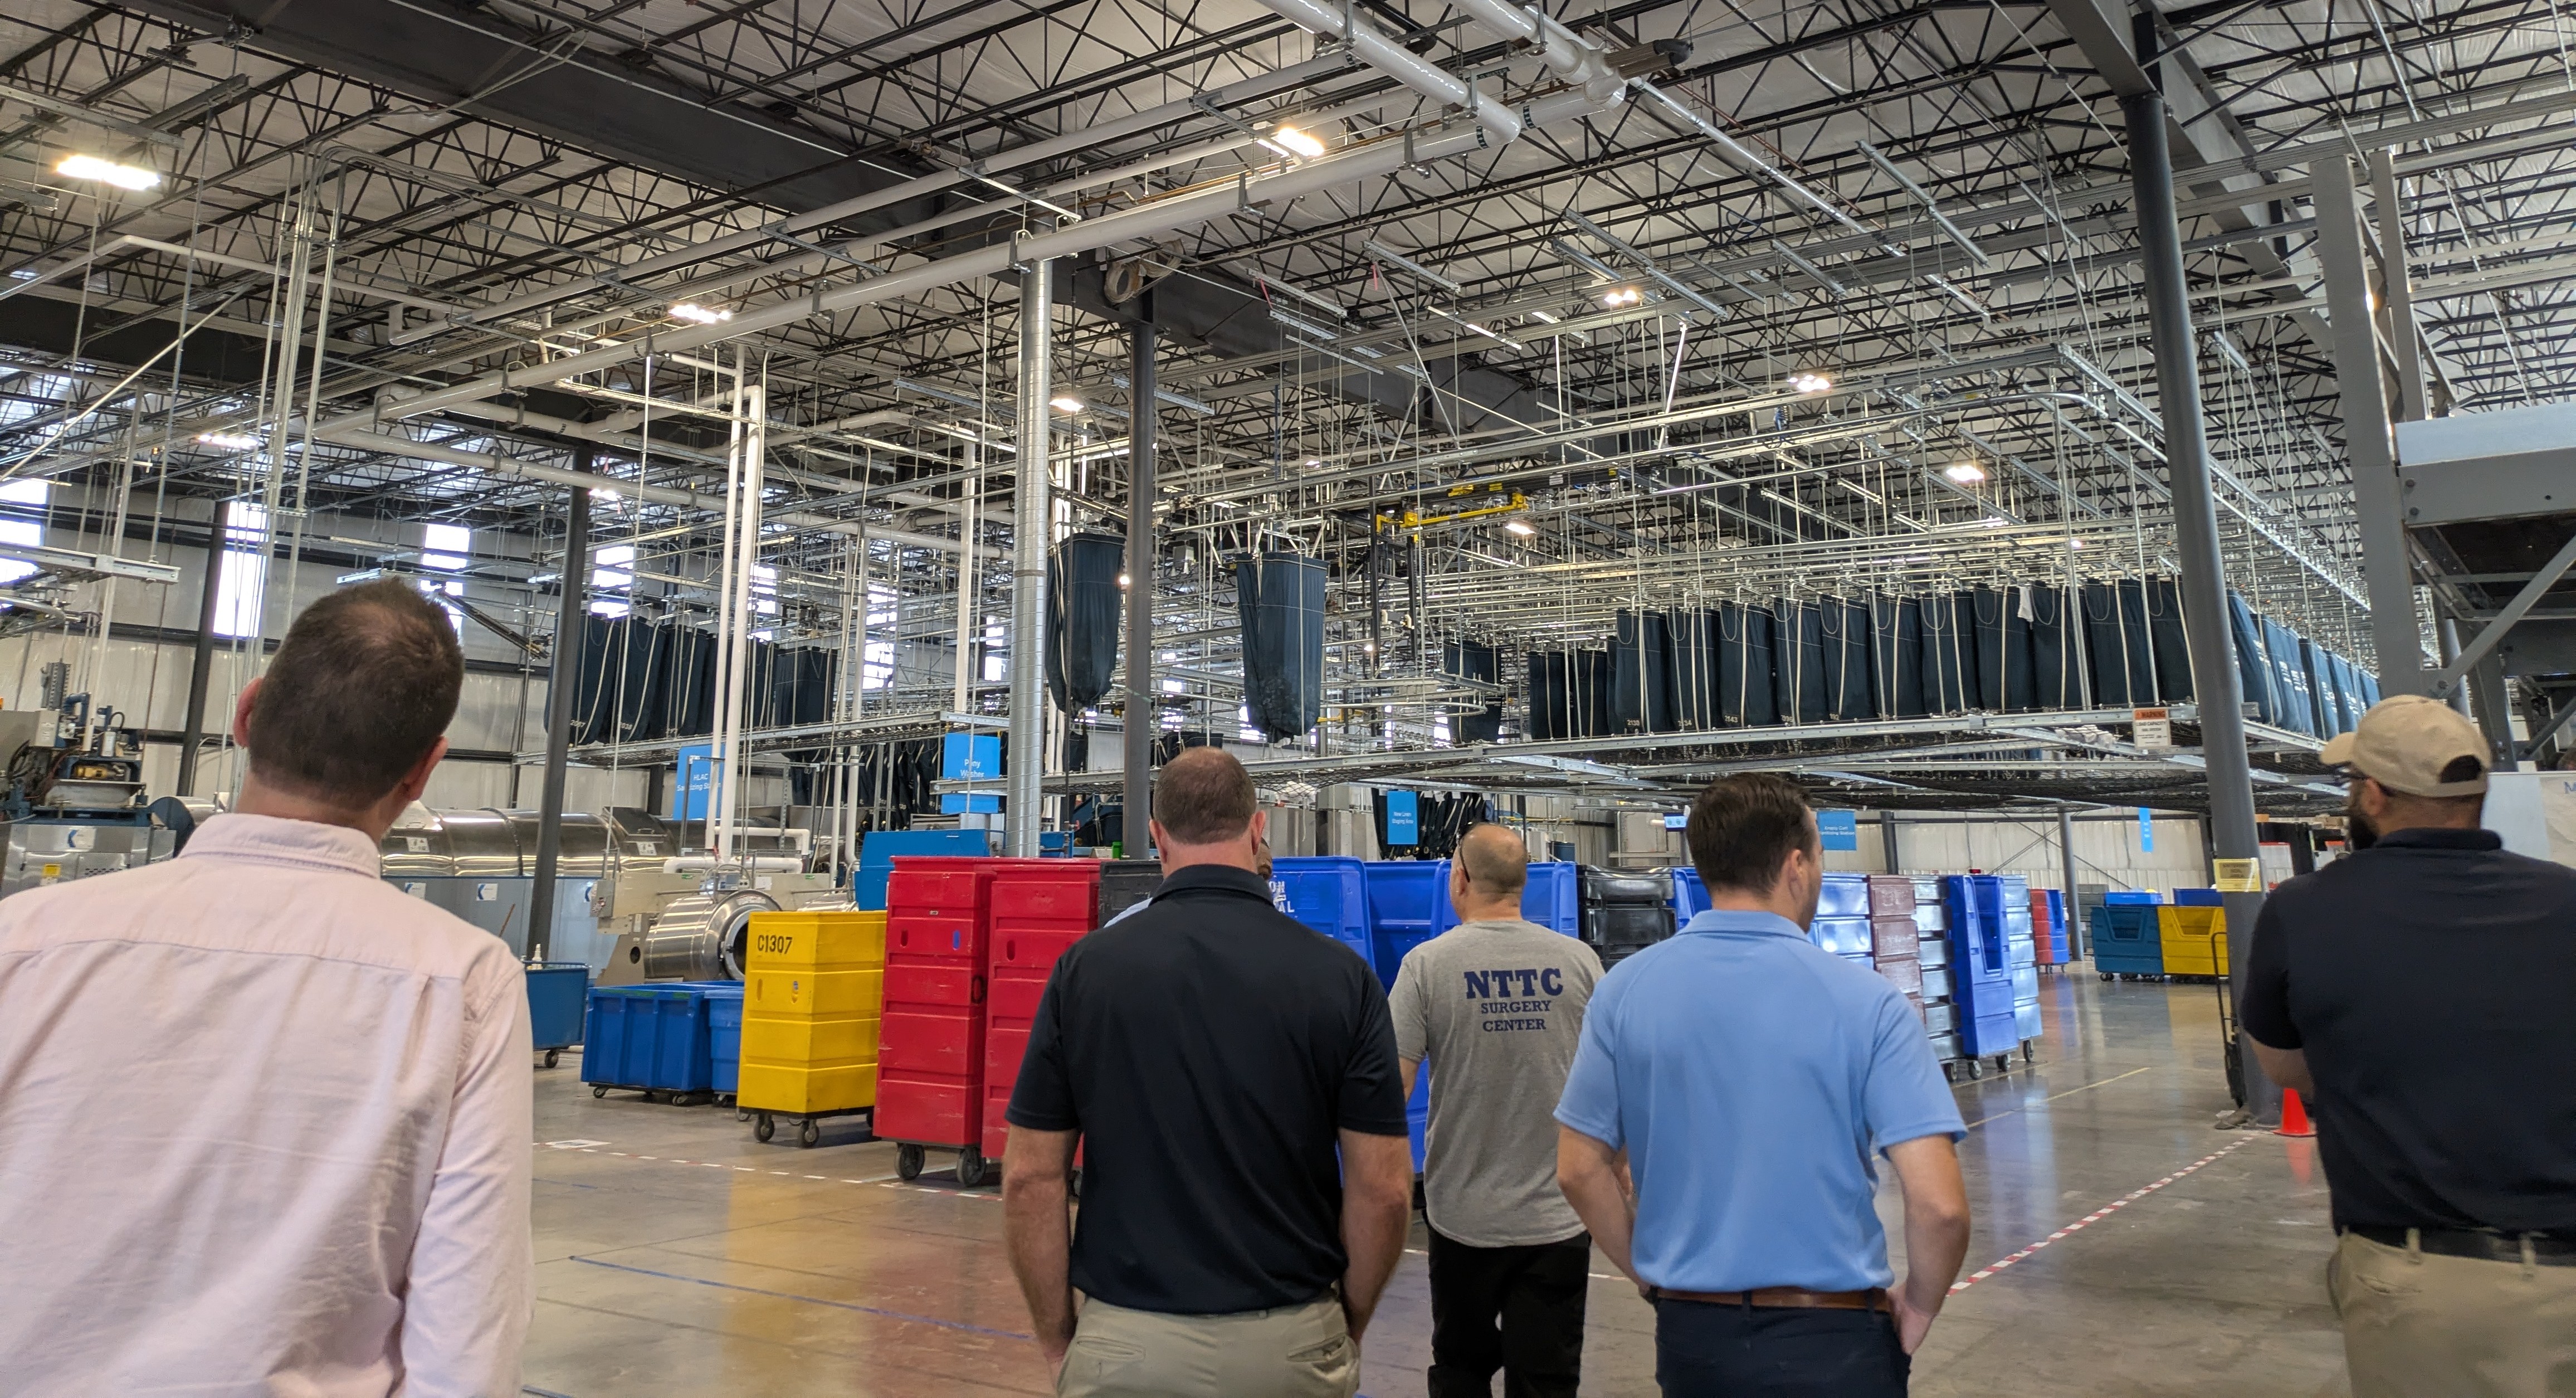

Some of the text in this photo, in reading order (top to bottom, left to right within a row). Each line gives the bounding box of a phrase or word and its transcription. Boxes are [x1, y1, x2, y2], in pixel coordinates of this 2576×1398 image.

[964, 759, 980, 768] Pny
[758, 934, 793, 954] C1307
[1464, 968, 1563, 999] NTTC
[1481, 1000, 1552, 1014] SURGERY
[1482, 1019, 1546, 1032] CENTER
